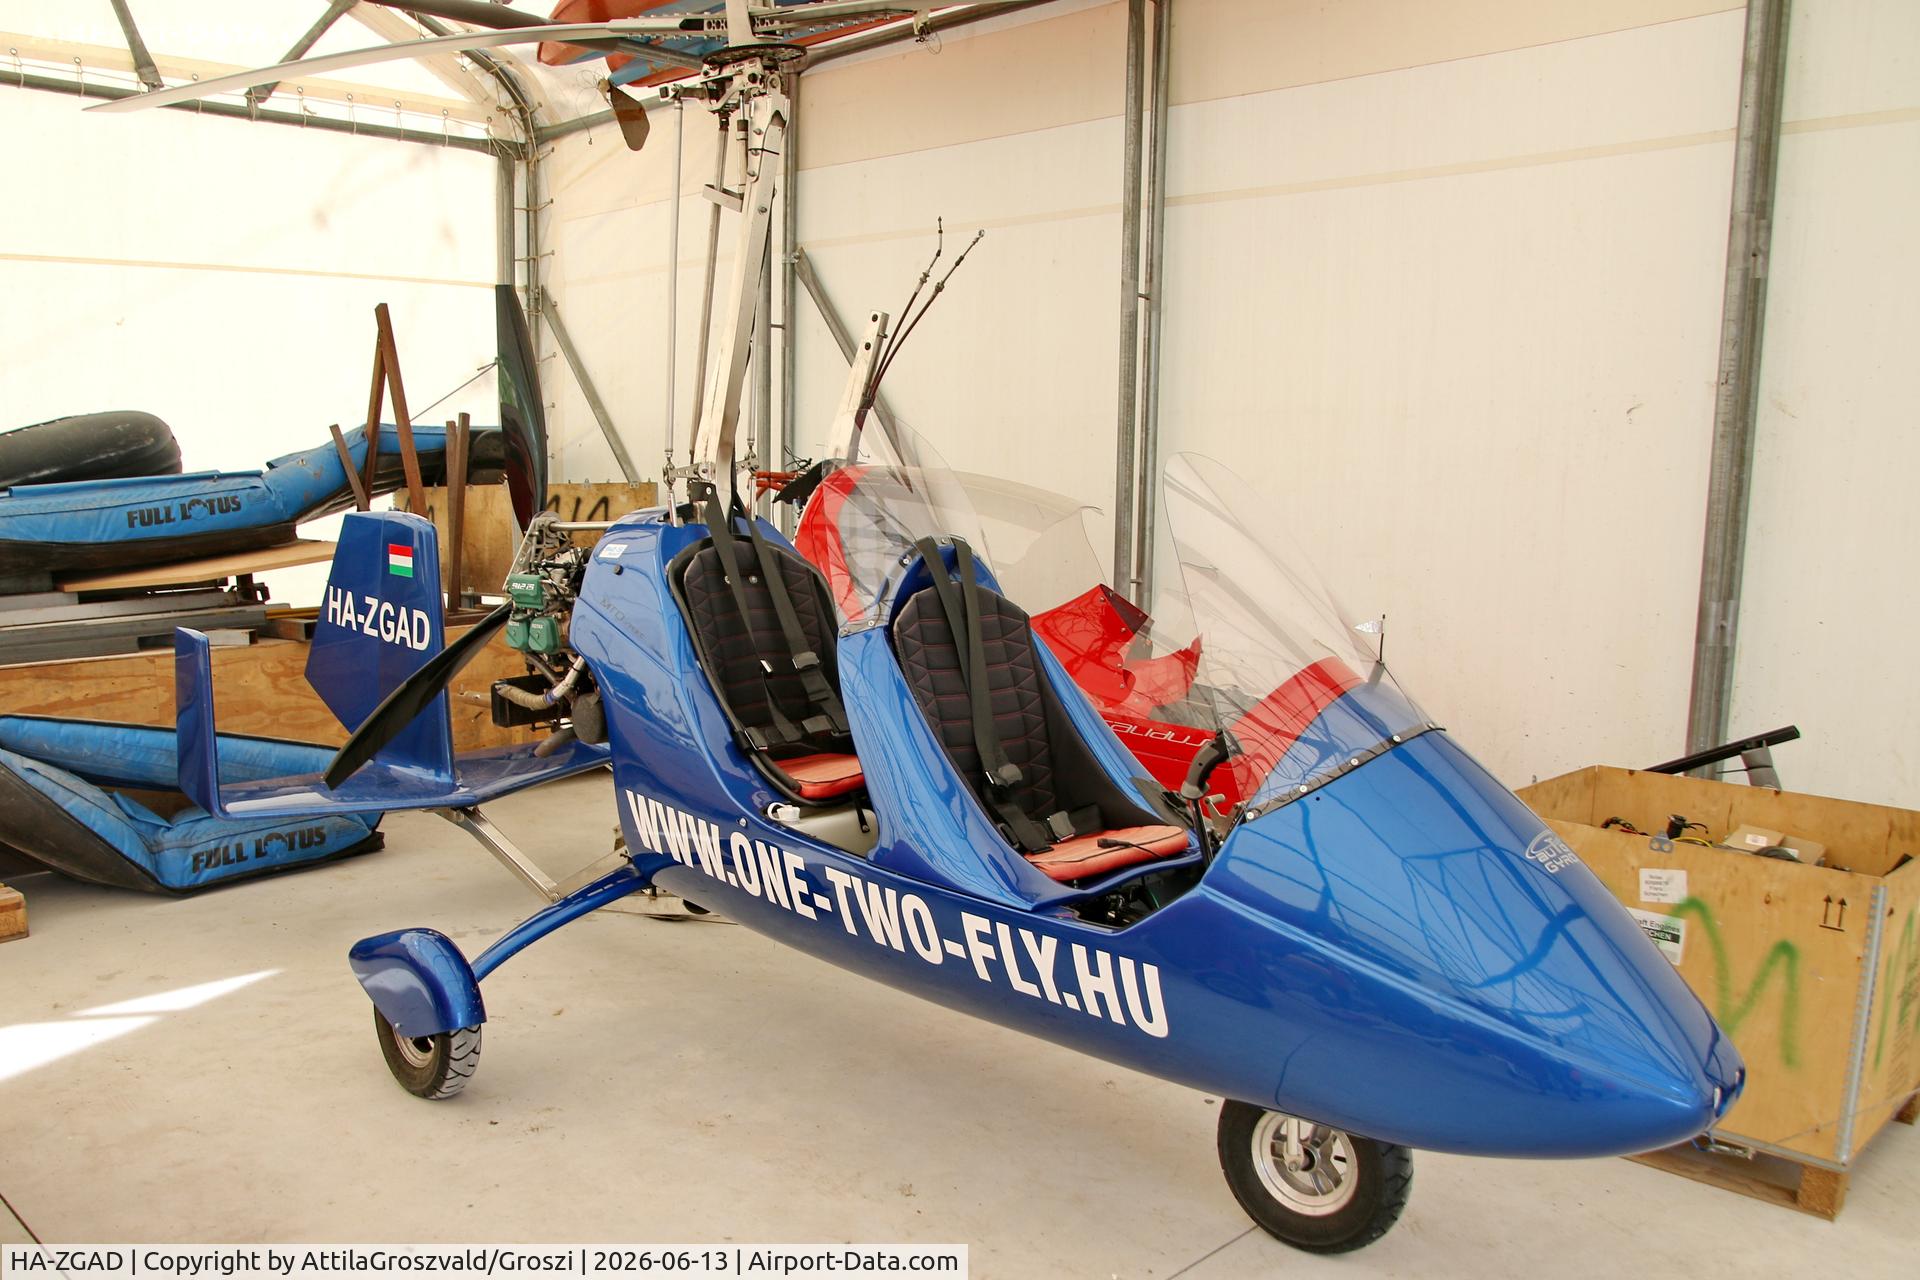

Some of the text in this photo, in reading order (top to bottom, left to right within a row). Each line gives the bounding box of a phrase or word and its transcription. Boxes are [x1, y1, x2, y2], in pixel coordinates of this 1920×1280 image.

[127, 506, 176, 529] FULL
[327, 585, 431, 651] HA-ZGAD
[191, 843, 249, 874] FULL
[625, 789, 1169, 1039] WWW.ONE-TWO-FLY.HU
